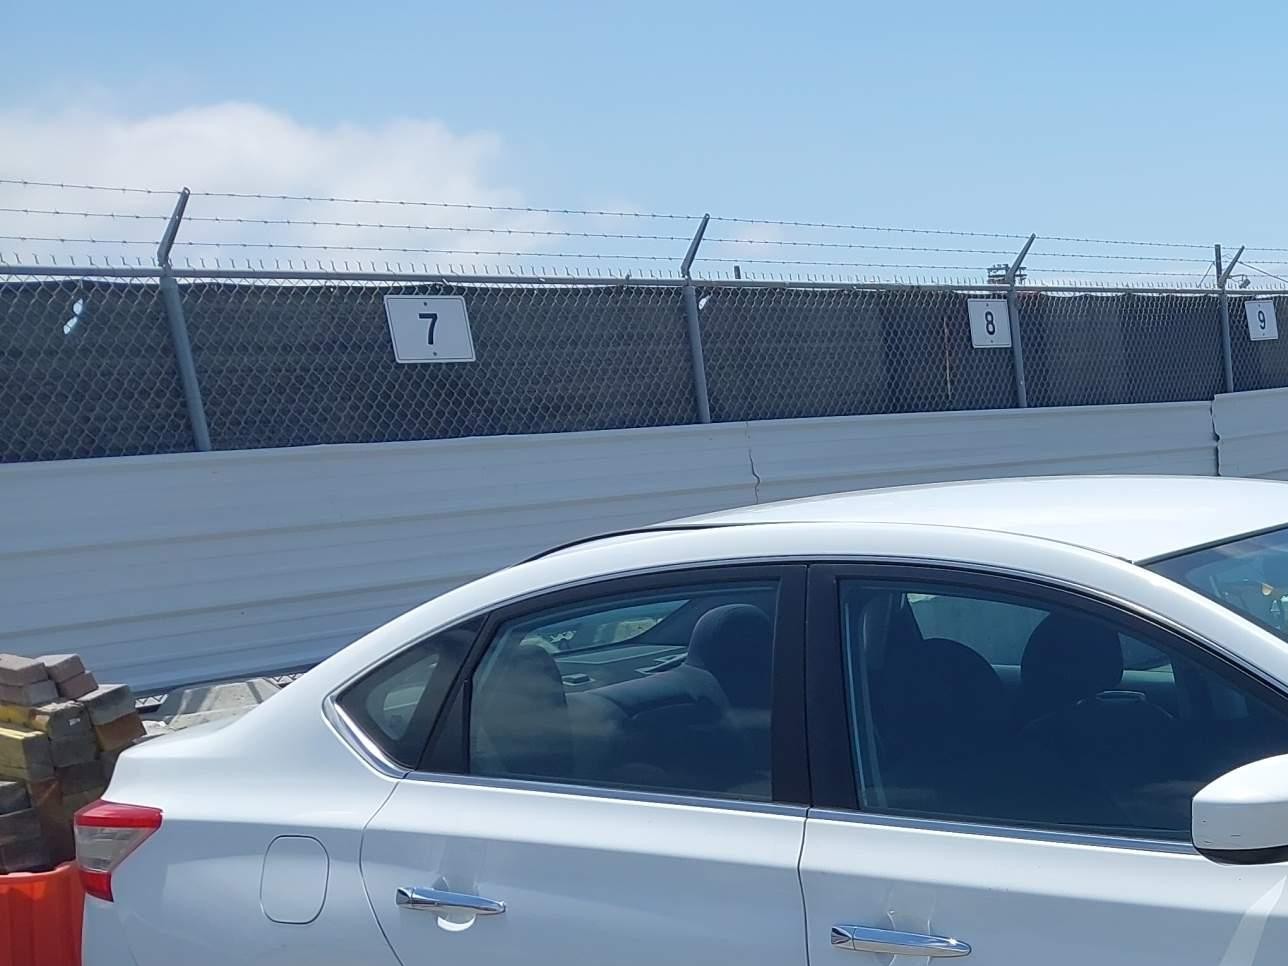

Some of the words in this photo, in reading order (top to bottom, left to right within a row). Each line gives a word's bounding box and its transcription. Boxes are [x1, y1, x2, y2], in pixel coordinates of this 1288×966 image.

[418, 312, 438, 345] 7
[984, 310, 996, 336] 8
[1257, 310, 1266, 330] 9
